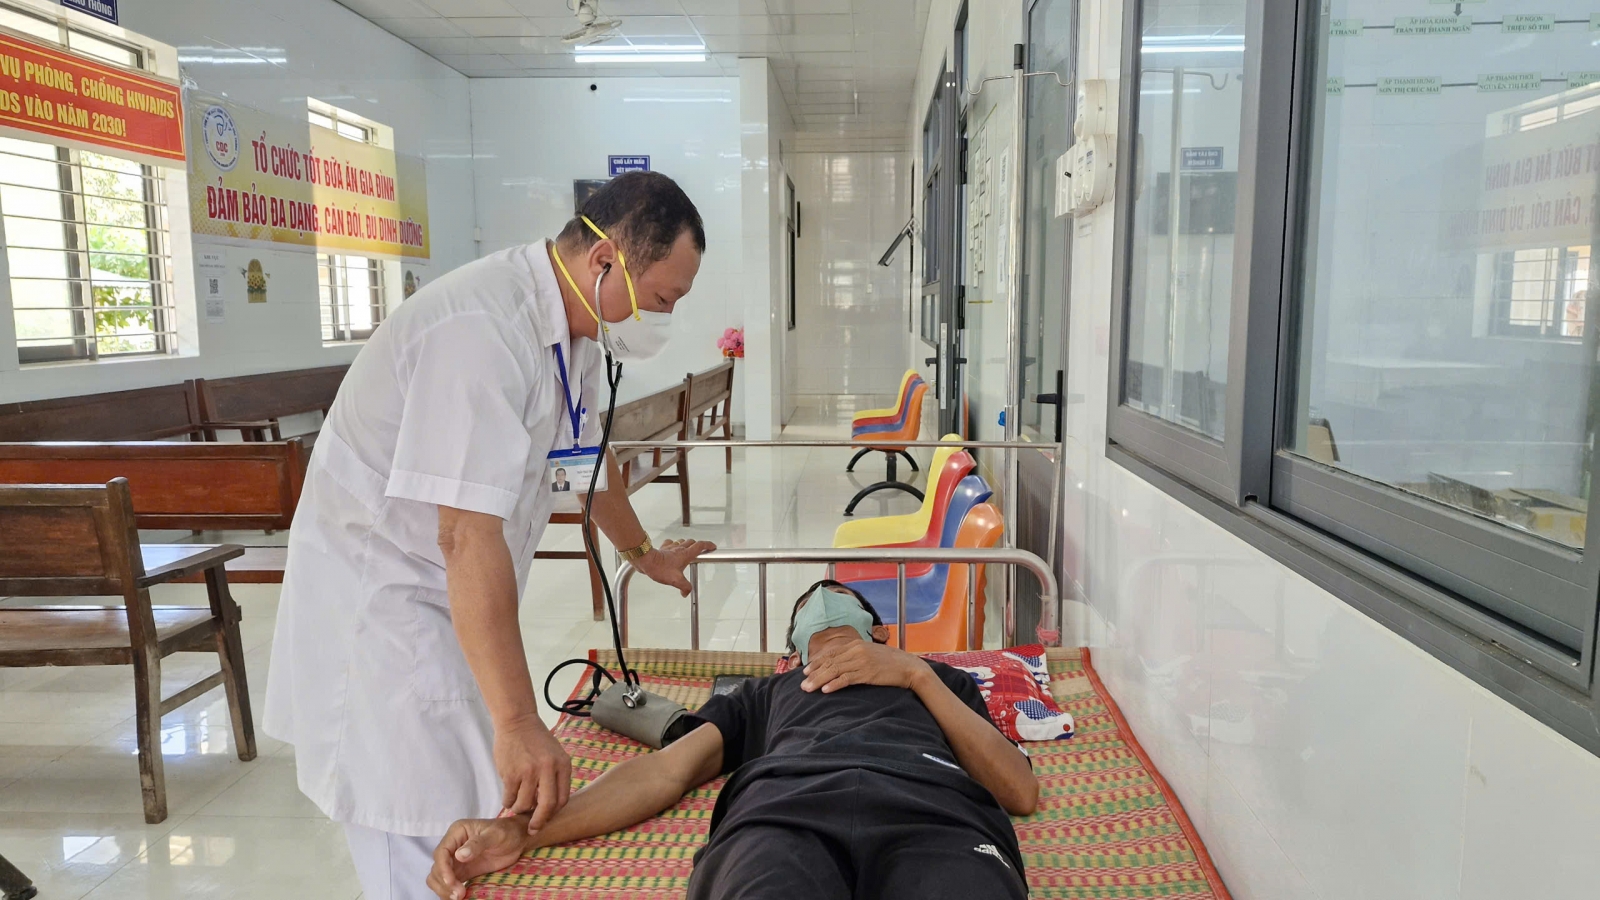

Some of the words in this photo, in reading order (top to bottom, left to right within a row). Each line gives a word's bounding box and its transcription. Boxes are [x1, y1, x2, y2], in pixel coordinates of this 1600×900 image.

[0, 54, 20, 83] VỤ
[24, 62, 78, 96] PHÒNG,
[81, 76, 124, 106] CHỐNG
[127, 90, 175, 119] HIV/AIDS
[24, 94, 53, 121] VÀO
[57, 102, 89, 129] NĂM
[92, 112, 126, 137] 2030!
[215, 141, 228, 153] CDC
[252, 130, 268, 173] TỔ
[271, 143, 301, 181] CHỨC
[302, 145, 321, 185] TỐT
[323, 155, 344, 190] BỮA
[345, 160, 358, 193] ĂN
[360, 169, 375, 197] GIA
[375, 169, 395, 201] ĐÌNH
[207, 176, 239, 221] ĐẢM
[242, 183, 267, 226] BẢO
[270, 197, 287, 228] ĐA
[289, 200, 322, 237] DẠNG,
[324, 202, 344, 236] CÂN
[346, 203, 365, 240] ĐỐI,
[365, 207, 377, 240] ĐỦ
[379, 217, 398, 243] DINH
[399, 217, 423, 247] DƯỠNG
